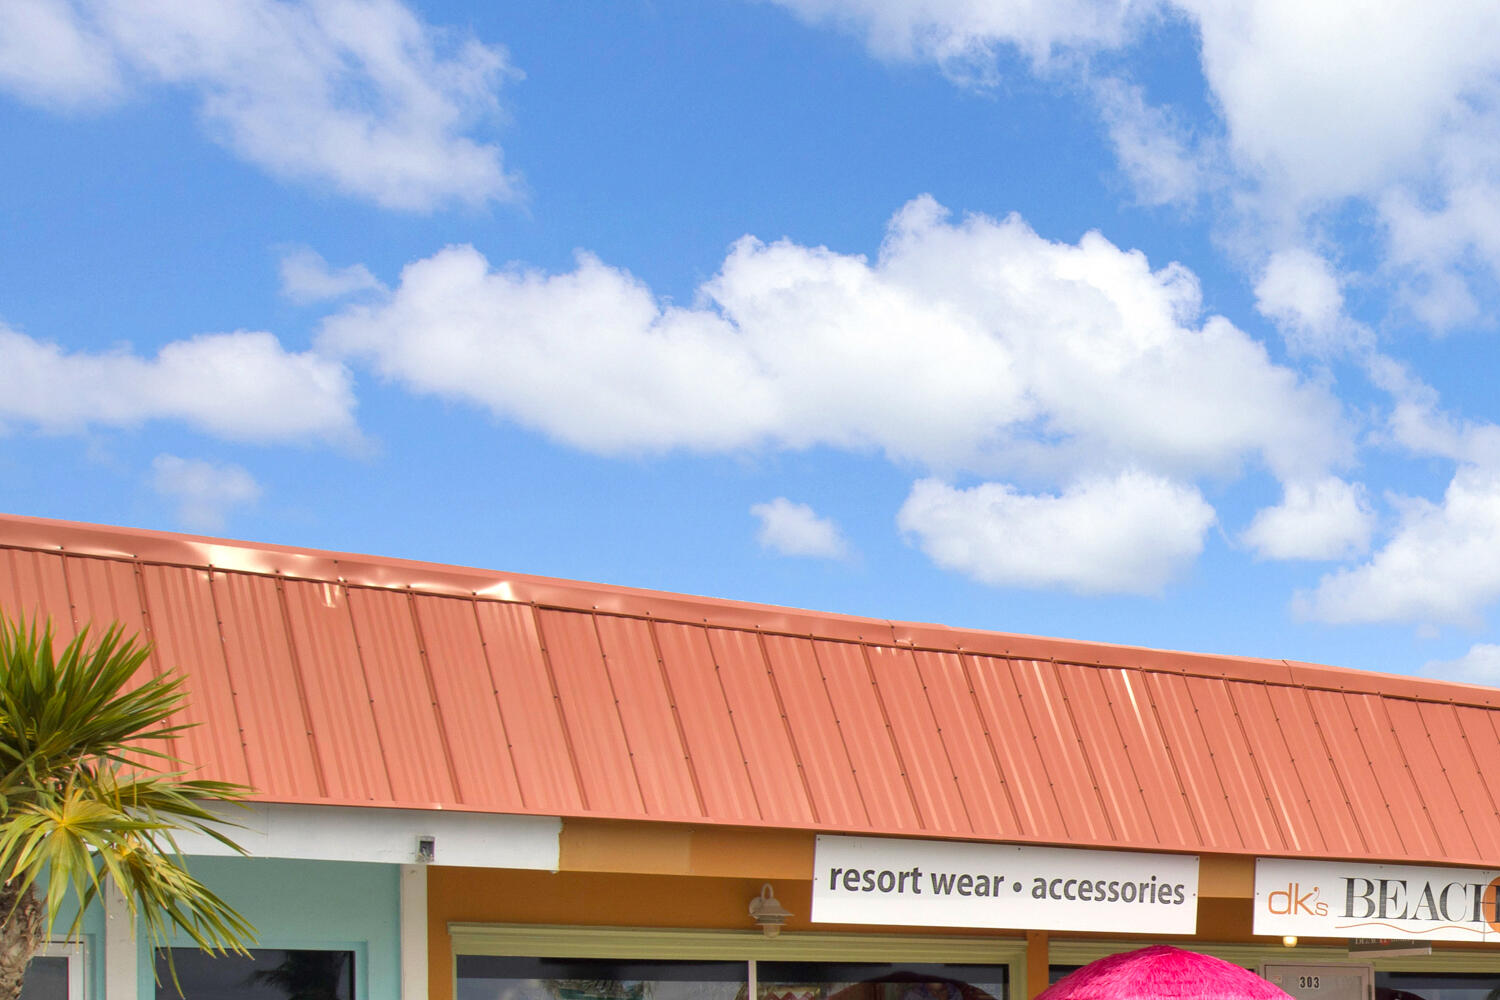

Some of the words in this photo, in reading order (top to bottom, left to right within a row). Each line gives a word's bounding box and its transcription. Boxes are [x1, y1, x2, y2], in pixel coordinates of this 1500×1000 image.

[829, 866, 923, 895] resort
[931, 872, 1005, 898] wear
[1031, 875, 1186, 906] accessories
[1268, 882, 1330, 917] dk's
[1300, 976, 1320, 989] 303
